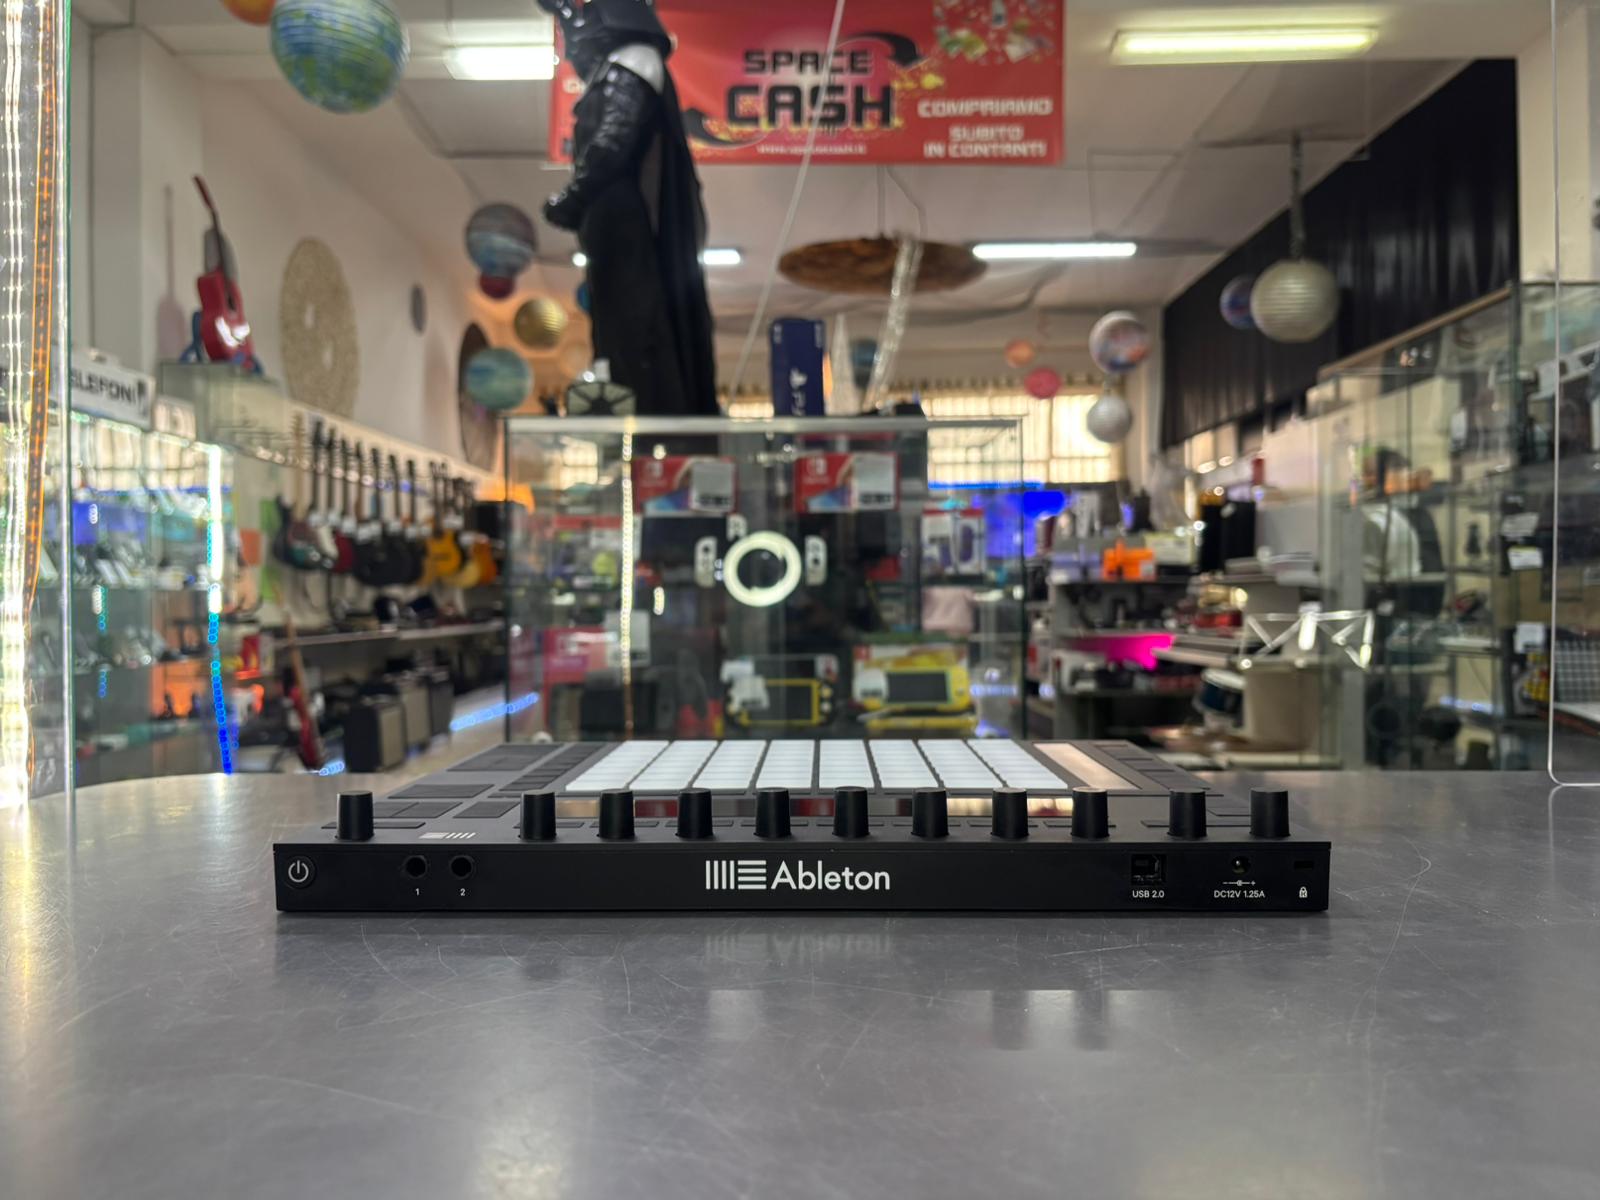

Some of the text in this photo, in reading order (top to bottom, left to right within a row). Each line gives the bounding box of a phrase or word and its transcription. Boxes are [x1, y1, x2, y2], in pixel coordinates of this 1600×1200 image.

[744, 50, 869, 73] SPACE
[727, 84, 892, 127] CASH
[917, 98, 1053, 117] COMPRIAMO
[949, 125, 1024, 142] SUBITO
[923, 141, 1047, 158] IN CONTANTI
[71, 367, 137, 404] ELEFONI
[770, 860, 891, 891] Ableton
[415, 887, 420, 896] 1
[460, 887, 466, 897] 2
[1132, 890, 1165, 898] USB 2.0
[1213, 890, 1266, 898] DC12V 1.25A
